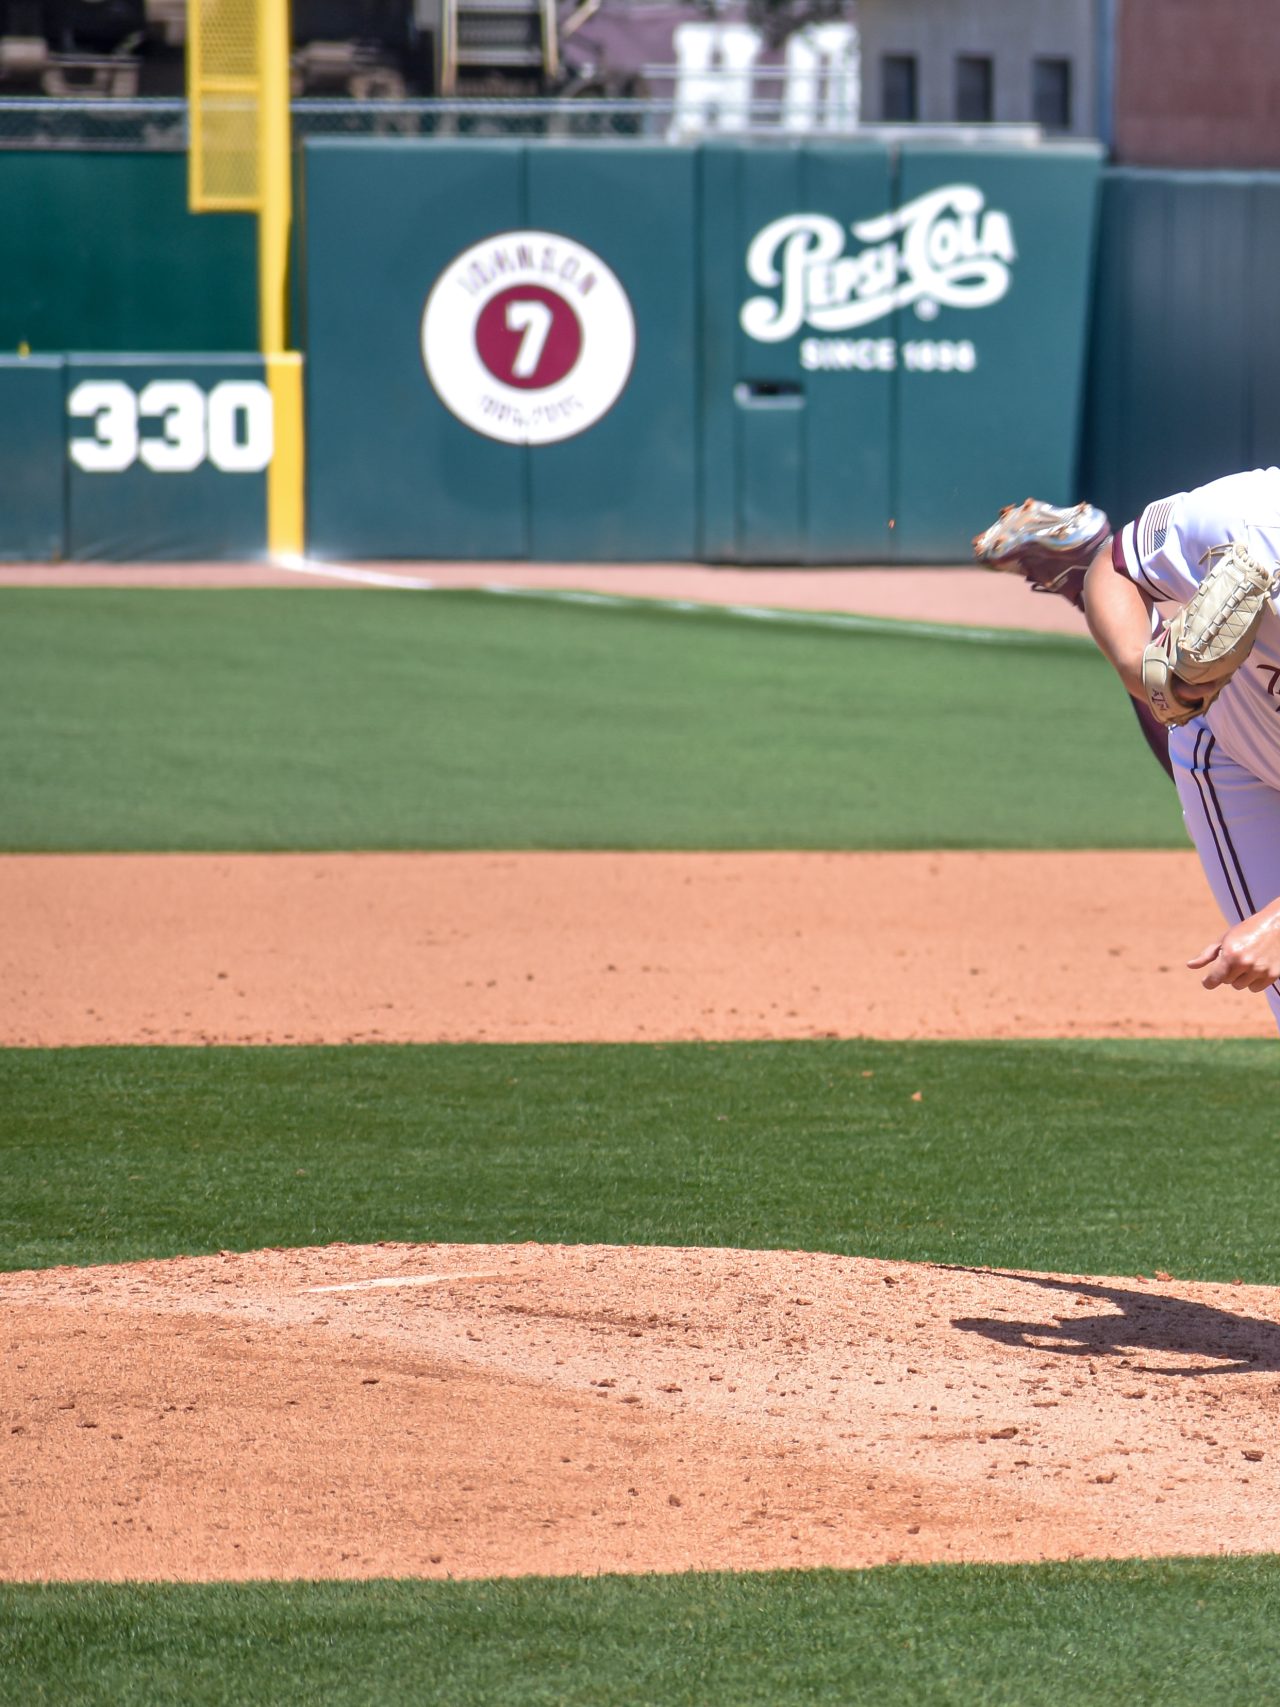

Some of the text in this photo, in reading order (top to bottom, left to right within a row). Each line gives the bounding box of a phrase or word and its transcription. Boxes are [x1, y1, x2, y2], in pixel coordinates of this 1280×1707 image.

[505, 299, 554, 379] 7
[800, 338, 896, 371] SINCE
[68, 379, 274, 473] 330
